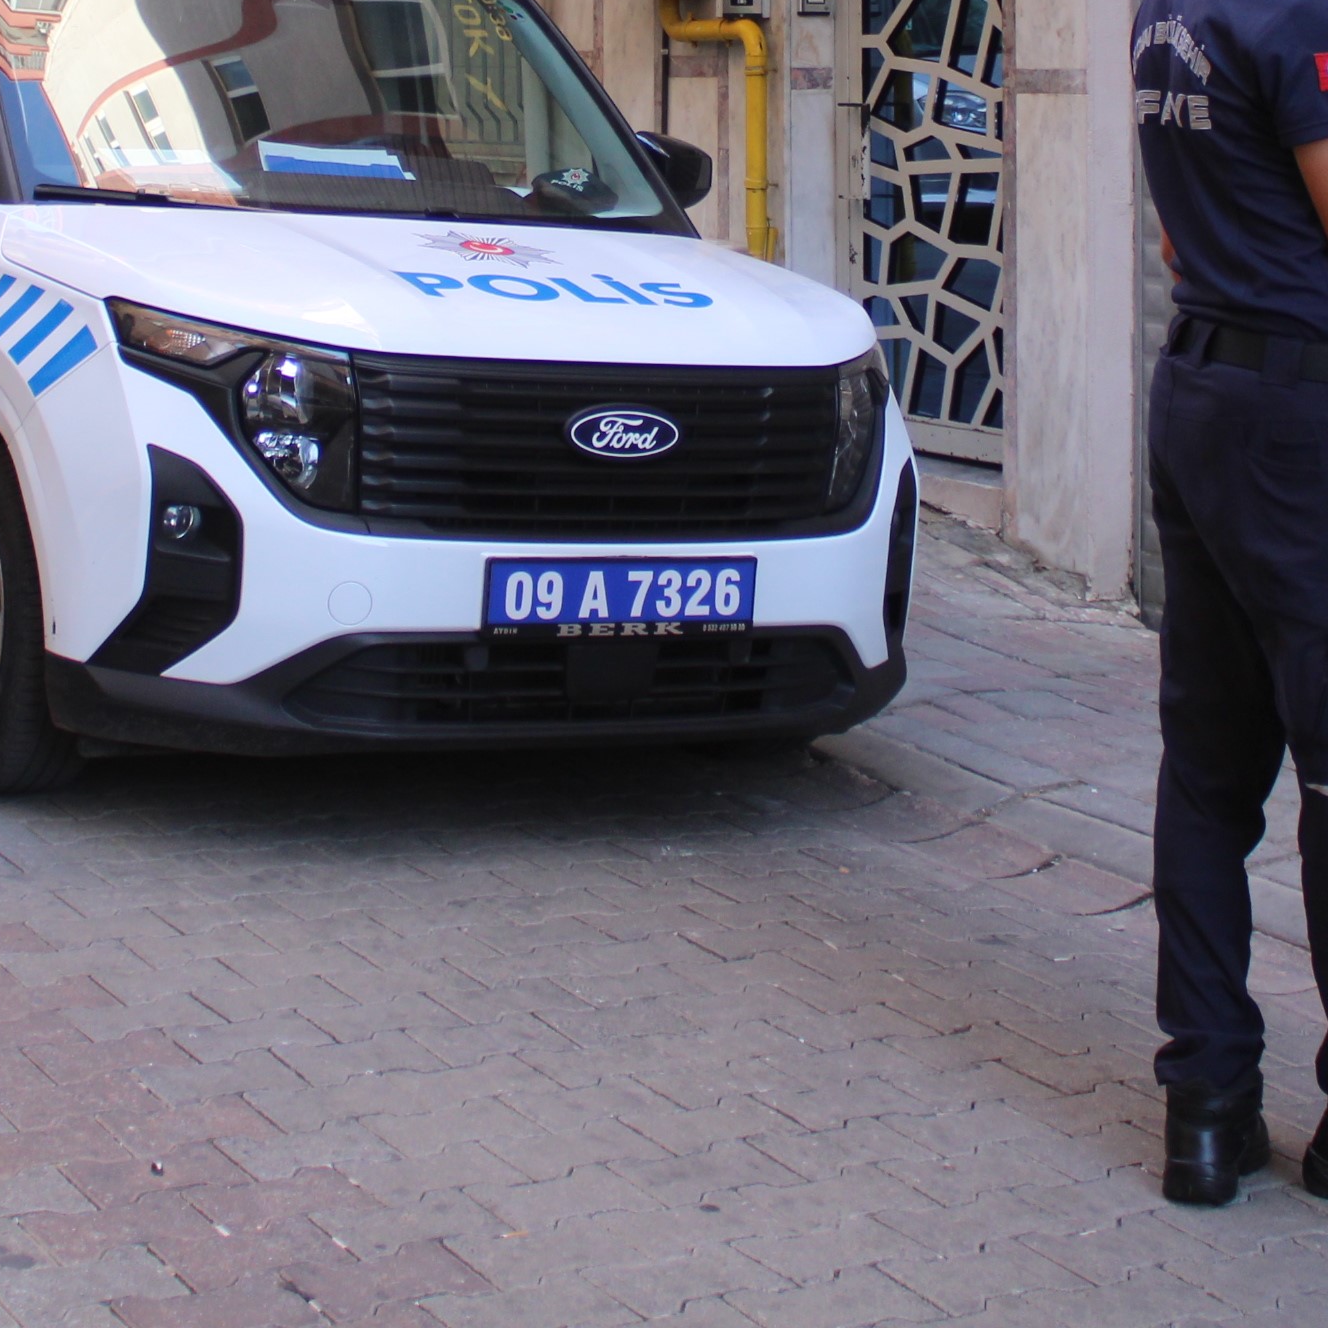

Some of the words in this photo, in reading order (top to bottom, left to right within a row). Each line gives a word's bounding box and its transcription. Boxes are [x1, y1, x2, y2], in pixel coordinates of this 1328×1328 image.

[394, 271, 714, 308] POLİS
[591, 416, 659, 450] Ford
[505, 570, 564, 620] 09
[578, 570, 609, 619] A
[627, 568, 741, 618] 7326
[557, 622, 683, 637] BERK
